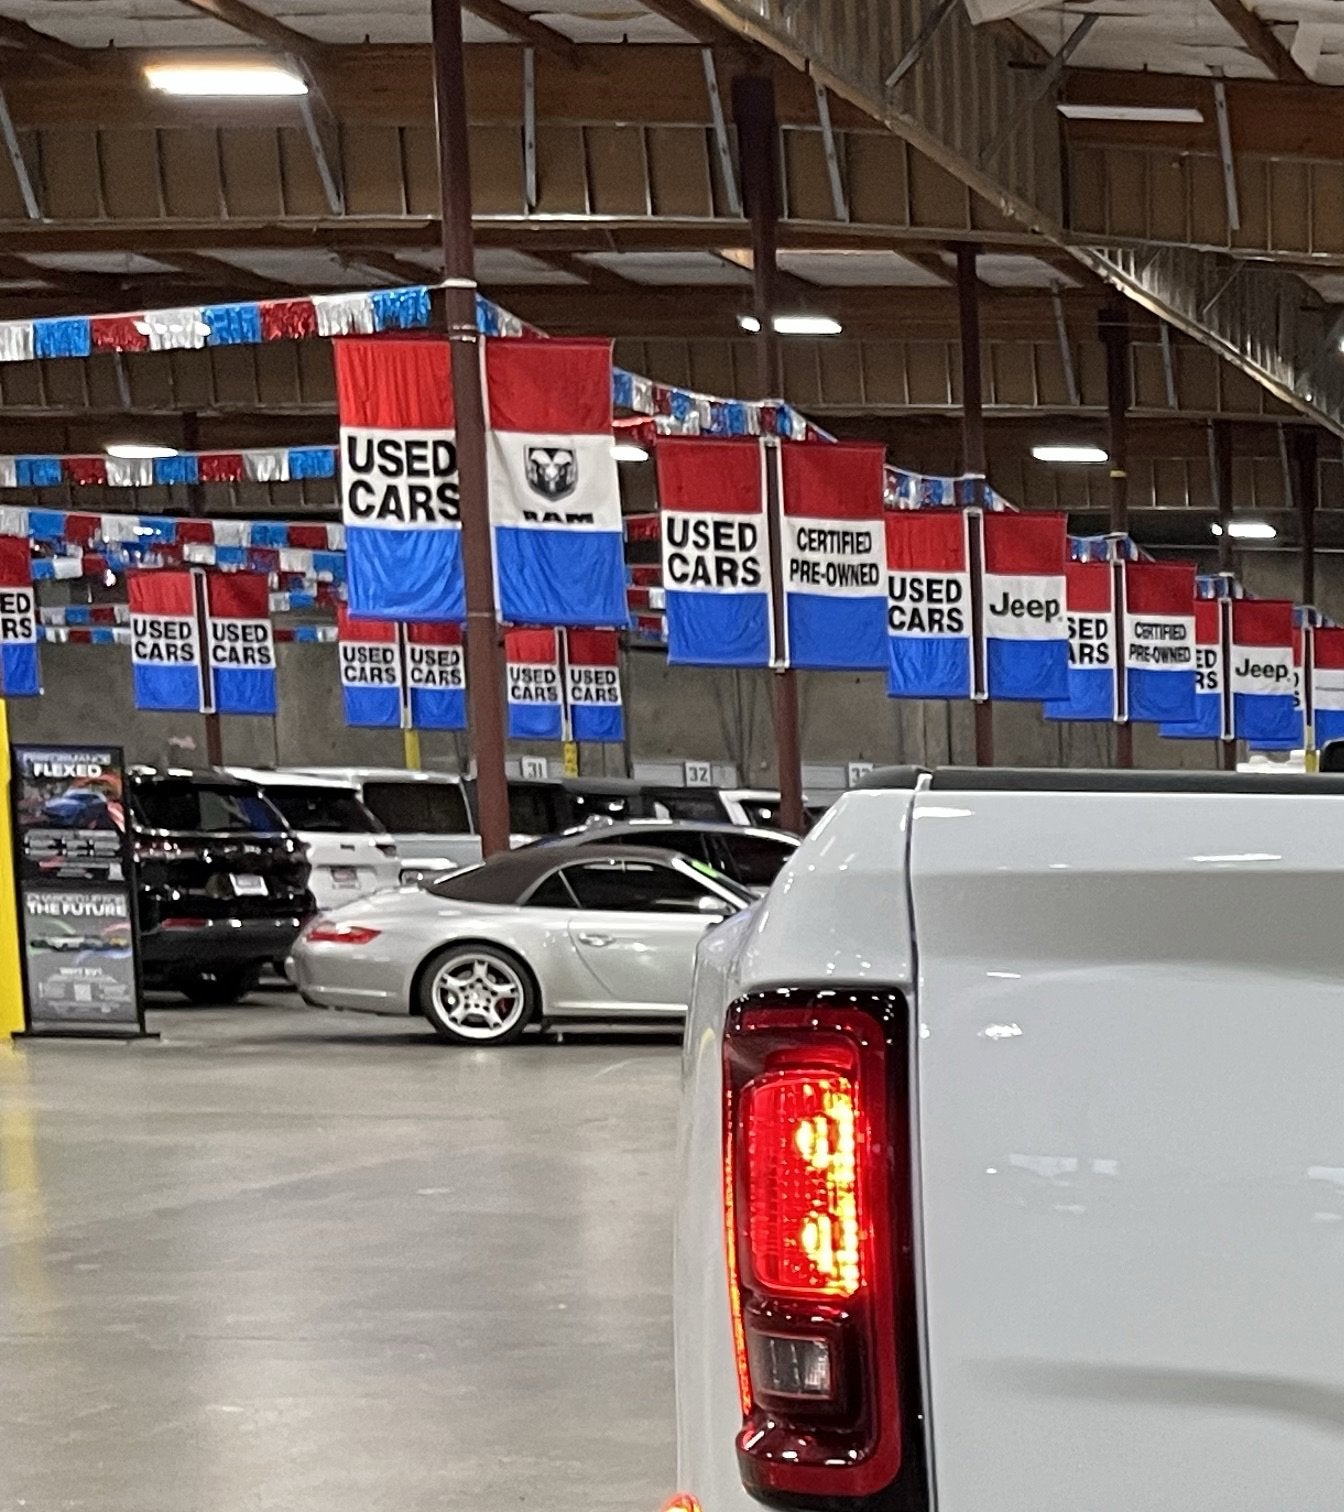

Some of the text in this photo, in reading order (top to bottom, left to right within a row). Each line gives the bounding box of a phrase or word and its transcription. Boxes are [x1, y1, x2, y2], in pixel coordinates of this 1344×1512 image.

[347, 435, 458, 478] USED
[349, 479, 461, 523] CARS
[522, 509, 595, 525] RAM
[666, 517, 758, 552] USED
[797, 527, 872, 554] CERTIFIED
[667, 552, 762, 587] CARS
[790, 558, 880, 587] PRE-OWNED
[888, 575, 962, 603] USED
[0, 592, 31, 614] ED
[989, 592, 1060, 622] Jeep
[0, 618, 33, 639] RS
[133, 618, 193, 640] USED
[888, 605, 964, 633] CARS
[1066, 616, 1108, 640] SED
[212, 622, 268, 643] USED
[135, 641, 195, 662] CARS
[212, 645, 272, 665] CARS
[343, 646, 395, 664] USED
[410, 646, 460, 666] USED
[1196, 649, 1218, 669] ED
[344, 666, 397, 684] CARS
[410, 666, 462, 686] CARS
[510, 666, 556, 684] USED
[570, 668, 616, 685] USED
[1196, 671, 1218, 690] RS
[1235, 658, 1289, 682] Jeep
[511, 685, 558, 702] CARS
[571, 686, 619, 703] CARS
[33, 762, 102, 778] FLEXED
[688, 767, 708, 783] 32
[27, 902, 126, 917] THE FUTURE
